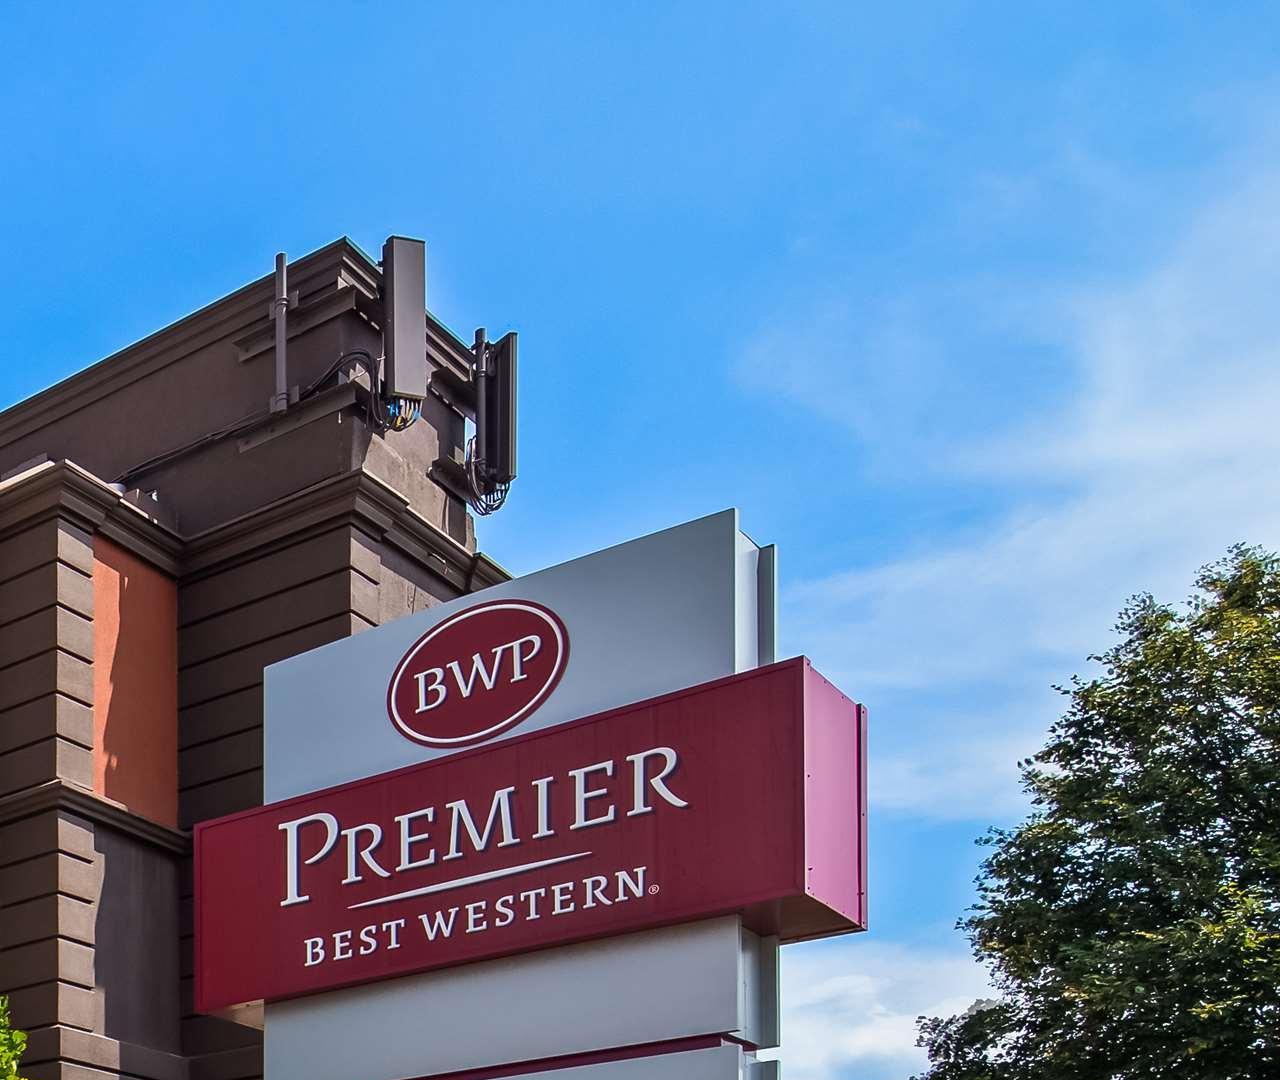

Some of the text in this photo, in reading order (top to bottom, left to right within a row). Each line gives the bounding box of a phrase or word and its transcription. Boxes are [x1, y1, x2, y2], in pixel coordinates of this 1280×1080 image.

[414, 634, 541, 714] BWP
[277, 746, 689, 907] PREMIER
[303, 917, 406, 967] BEST
